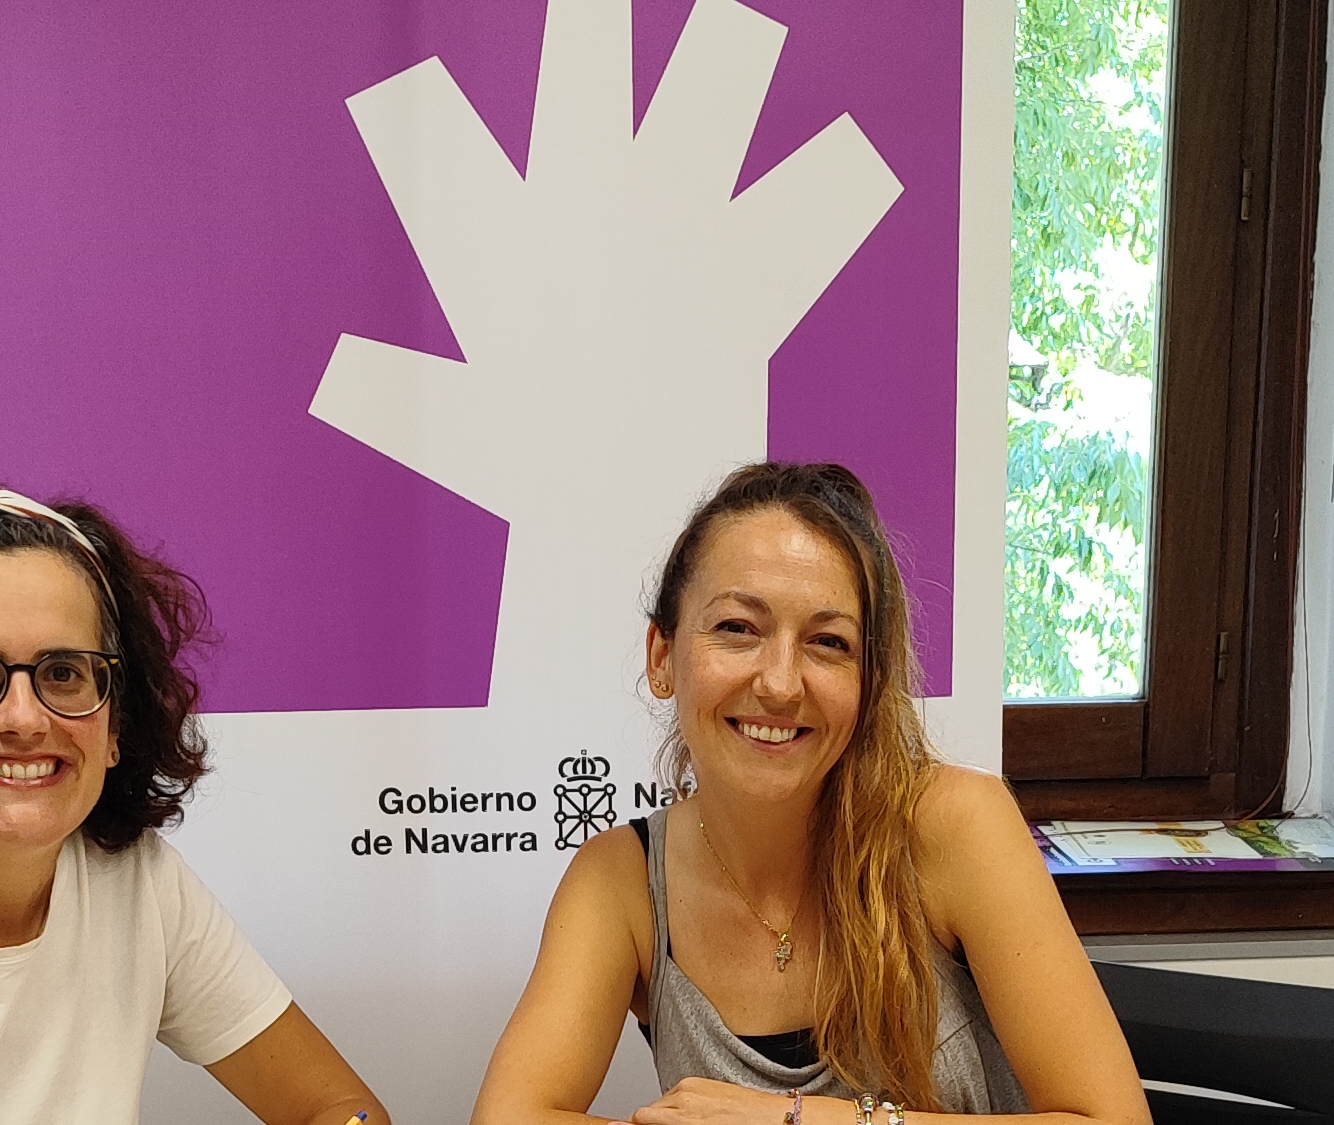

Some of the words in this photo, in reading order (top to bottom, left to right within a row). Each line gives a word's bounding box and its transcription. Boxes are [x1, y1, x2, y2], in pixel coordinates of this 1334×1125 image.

[378, 786, 537, 815] Gobierno
[351, 828, 393, 856] de
[404, 827, 538, 855] Navarra
